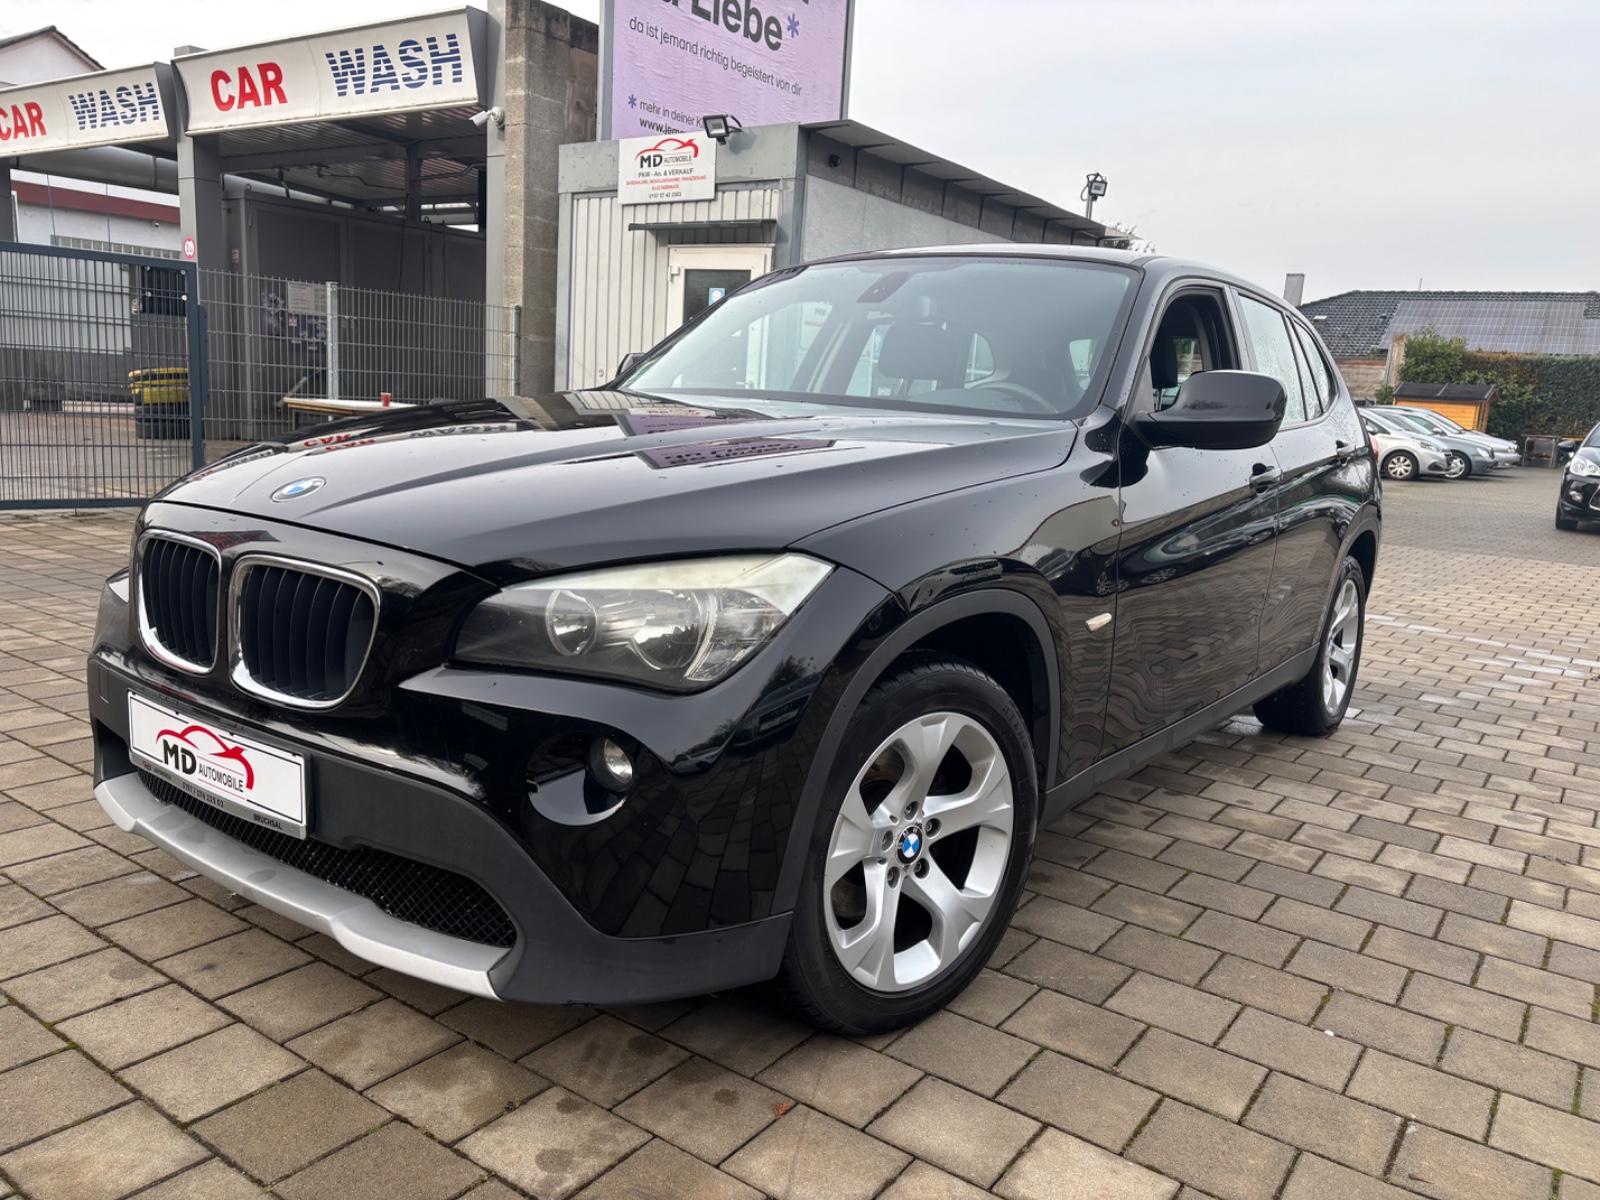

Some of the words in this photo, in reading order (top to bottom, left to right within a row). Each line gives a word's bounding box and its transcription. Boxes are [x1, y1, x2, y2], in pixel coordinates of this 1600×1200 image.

[211, 61, 288, 112] CAR
[326, 34, 464, 97] WASH
[630, 17, 644, 33] da
[646, 22, 659, 39] ist
[660, 27, 698, 55] jemand
[700, 45, 729, 70] richtig
[731, 56, 774, 86] begeistert
[775, 78, 791, 92] von
[791, 82, 802, 96] dir
[0, 102, 47, 141] CAR
[68, 82, 160, 131] WASH
[640, 101, 660, 115] mehr
[662, 107, 670, 118] in
[671, 110, 695, 125] deiner
[640, 154, 663, 169] MD
[669, 167, 694, 176] VERKAUF
[163, 739, 197, 775] MD
[198, 763, 244, 793] AUTOMOBILE
[253, 812, 282, 830] BRUCHSAL
